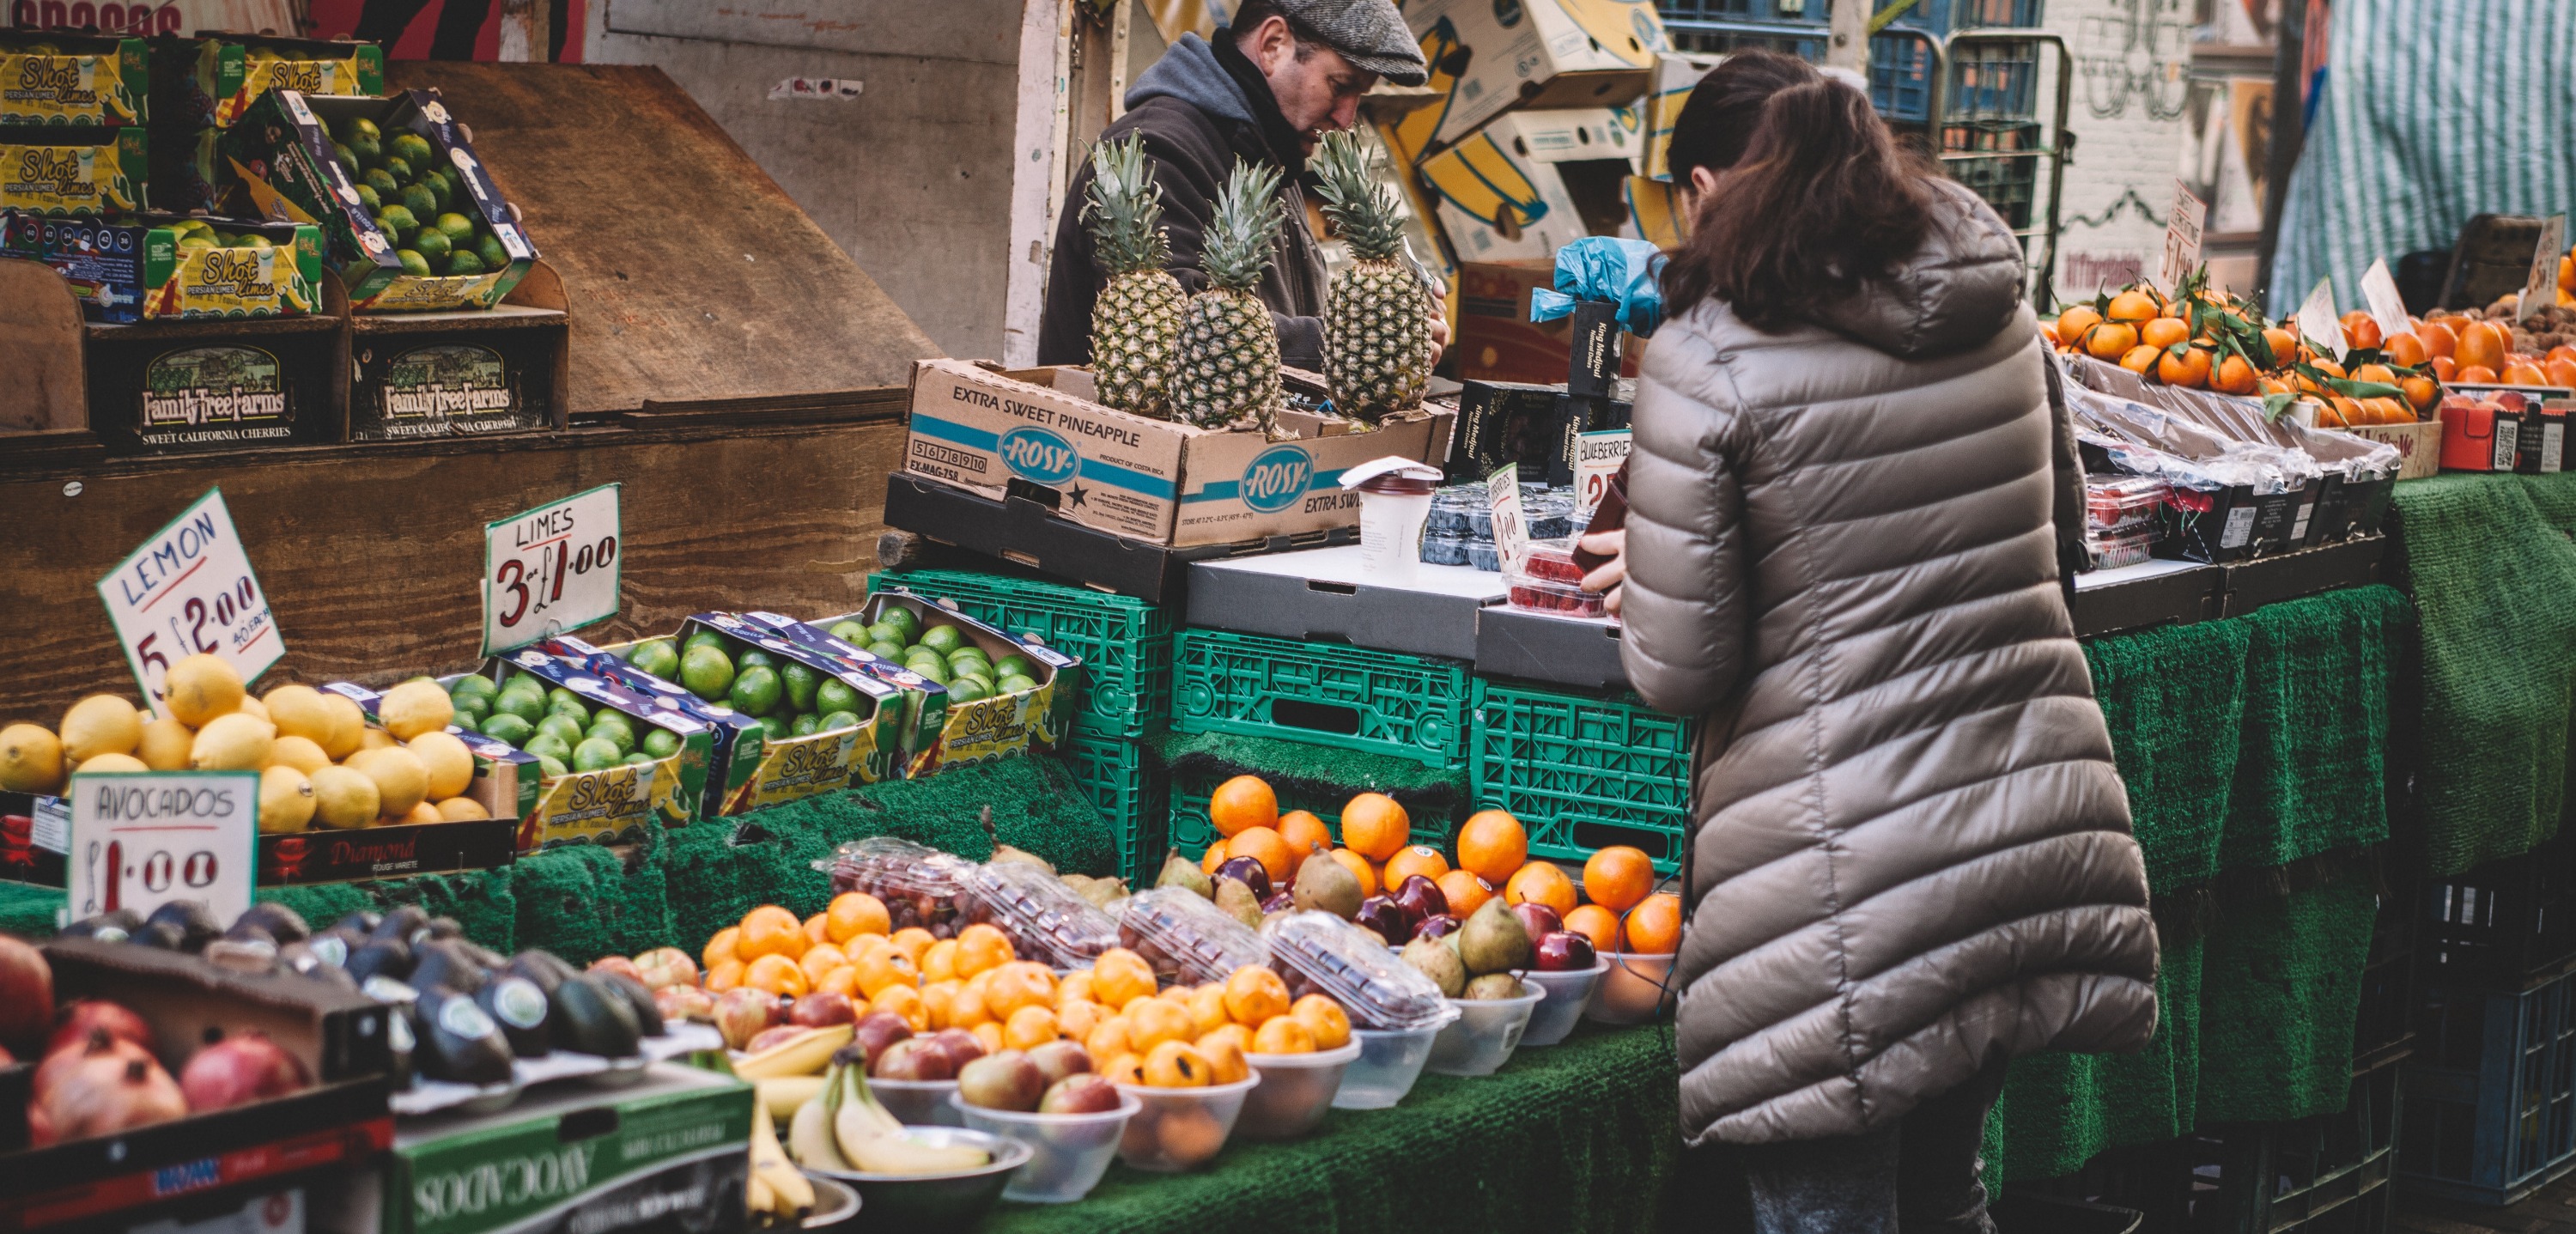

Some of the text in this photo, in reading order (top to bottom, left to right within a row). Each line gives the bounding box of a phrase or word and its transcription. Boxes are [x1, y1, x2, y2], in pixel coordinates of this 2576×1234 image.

[20, 56, 80, 89] Shot
[270, 62, 320, 91] Shot
[4, 90, 56, 100] PERSIAN LIMES
[20, 148, 79, 182] Shot
[4, 183, 56, 193] PERSIAN LIMES
[201, 249, 258, 284] Shot
[187, 285, 235, 296] PERSIAN LIMES
[1594, 322, 1607, 379] King Medjoul
[386, 424, 418, 439] SWEET
[953, 386, 1140, 448] EXTRA SWEET PINEAPPLE
[1466, 410, 1474, 434] Natural
[1467, 404, 1483, 459] King Medjoul
[1572, 416, 1581, 438] King
[143, 426, 291, 446] SWEET CALIFORNIA CHERRIES
[1564, 422, 1572, 447] Natural
[915, 442, 985, 471] 5 6 7 8 9 10
[1008, 435, 1072, 474] ROSY
[1100, 453, 1125, 465] PRODUCT
[1133, 463, 1151, 473] COSTA
[1151, 467, 1164, 476] RICA
[1248, 460, 1307, 499] ROSY
[1304, 494, 1338, 514] EXTRA
[516, 508, 574, 548] LIMES
[122, 512, 217, 606] LEMON
[497, 558, 530, 628] 3
[248, 607, 270, 634] EACH
[137, 631, 171, 702] 5
[965, 694, 1018, 736] Shot
[949, 732, 993, 749] PERSIAN LIMES
[782, 736, 841, 778] Shot
[569, 768, 637, 812] Shot
[763, 774, 811, 792] PERSIAN LIMES
[96, 785, 235, 820] AVOCADOS
[550, 806, 607, 825] PERSIAN LIMES
[331, 836, 416, 866] Diamond
[373, 862, 394, 872] ROUGE
[414, 1141, 595, 1225] AVOCADOS
